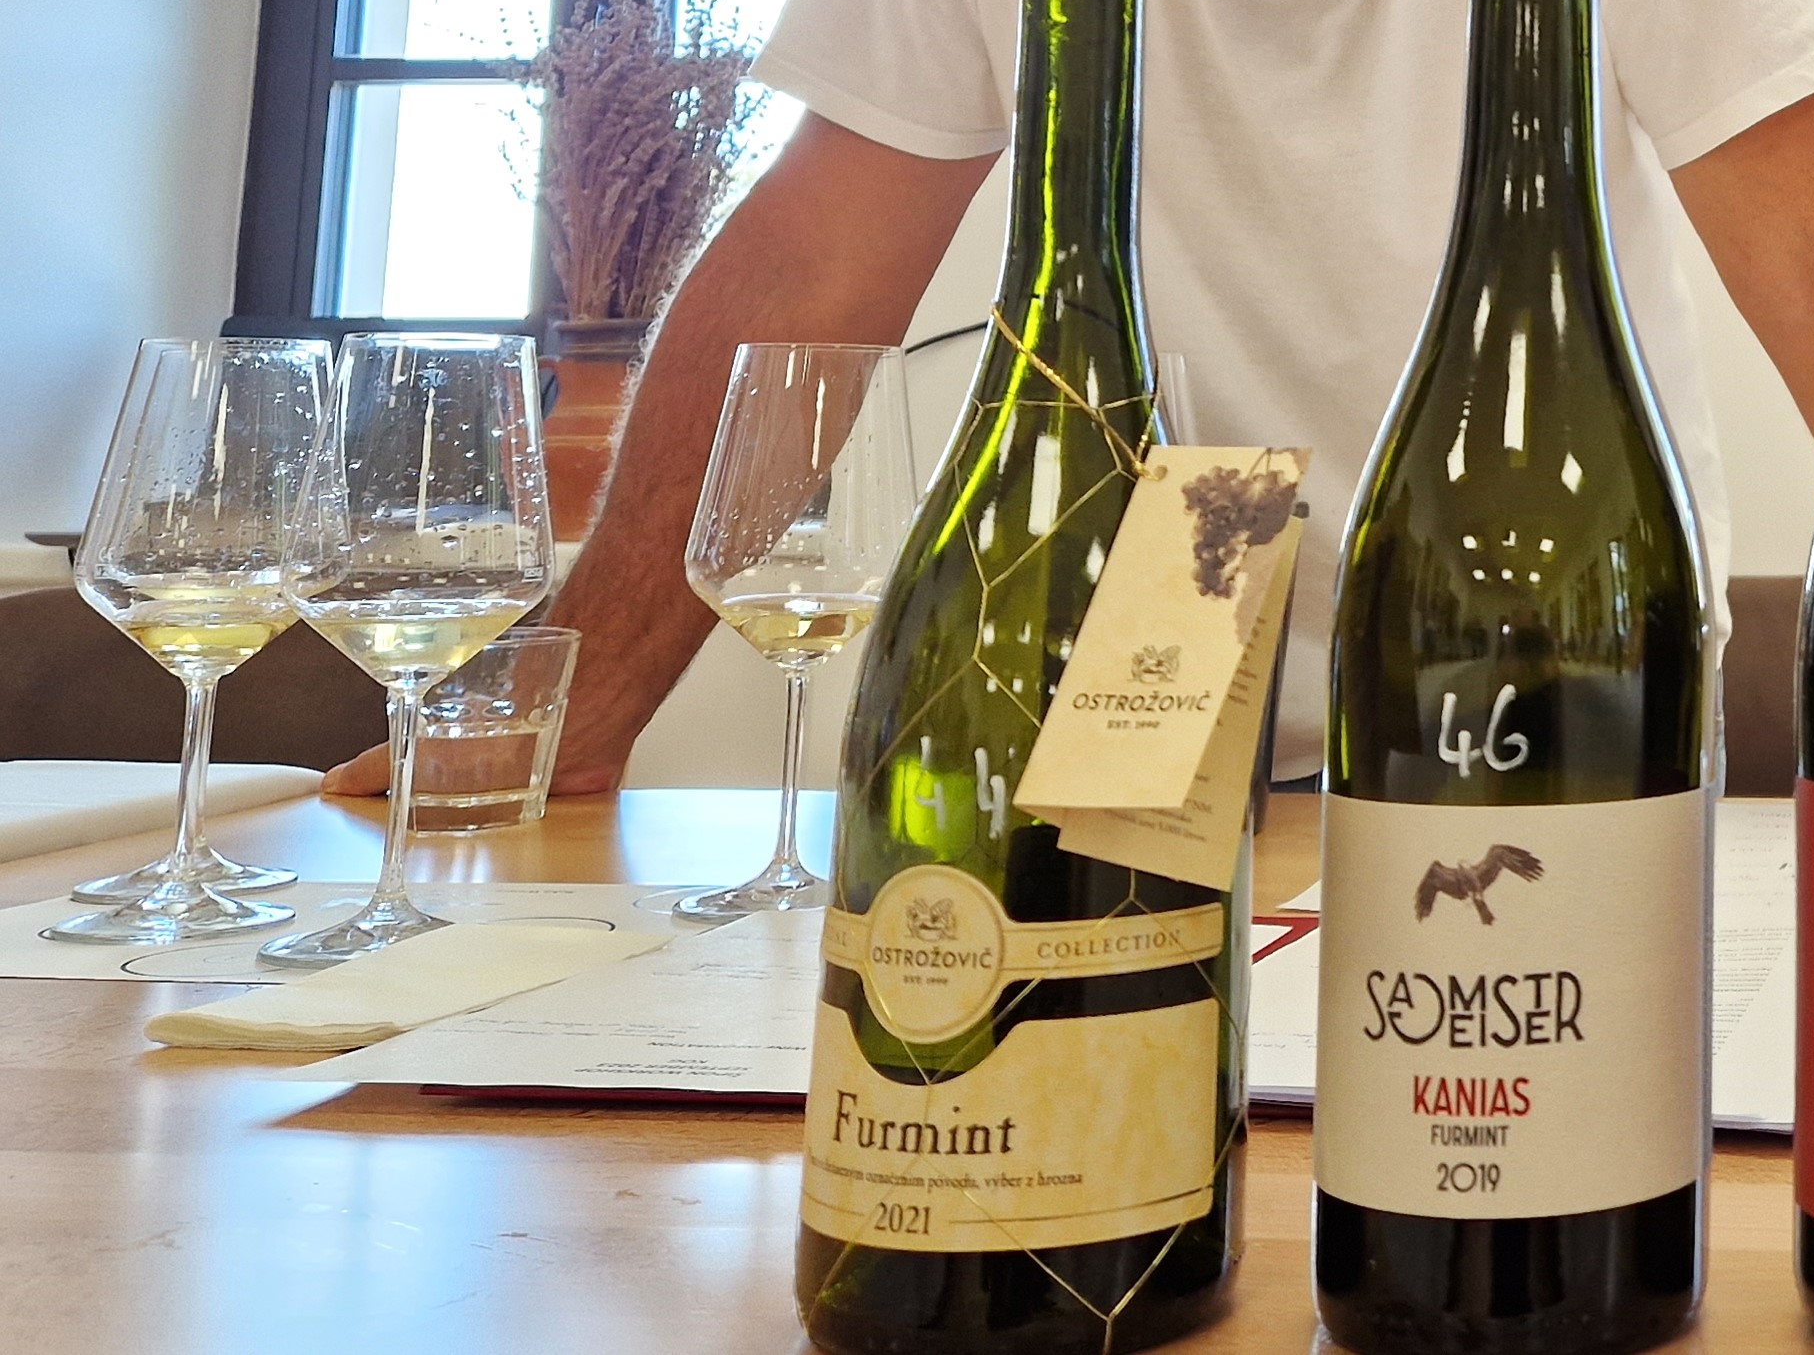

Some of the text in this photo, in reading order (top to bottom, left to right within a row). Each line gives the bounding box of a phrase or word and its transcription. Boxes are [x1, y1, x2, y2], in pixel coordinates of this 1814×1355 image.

[1072, 690, 1213, 713] OSTROŽOVIČ
[1438, 683, 1529, 779] 46
[871, 946, 993, 971] OSTROŽOVIČ
[1037, 929, 1181, 960] COLLECTION
[1412, 1075, 1532, 1117] KANIAS
[833, 1090, 1016, 1155] Furmint
[1430, 1124, 1510, 1147] FURMINT
[1436, 1162, 1501, 1193] 2019
[873, 1201, 931, 1235] 2021
